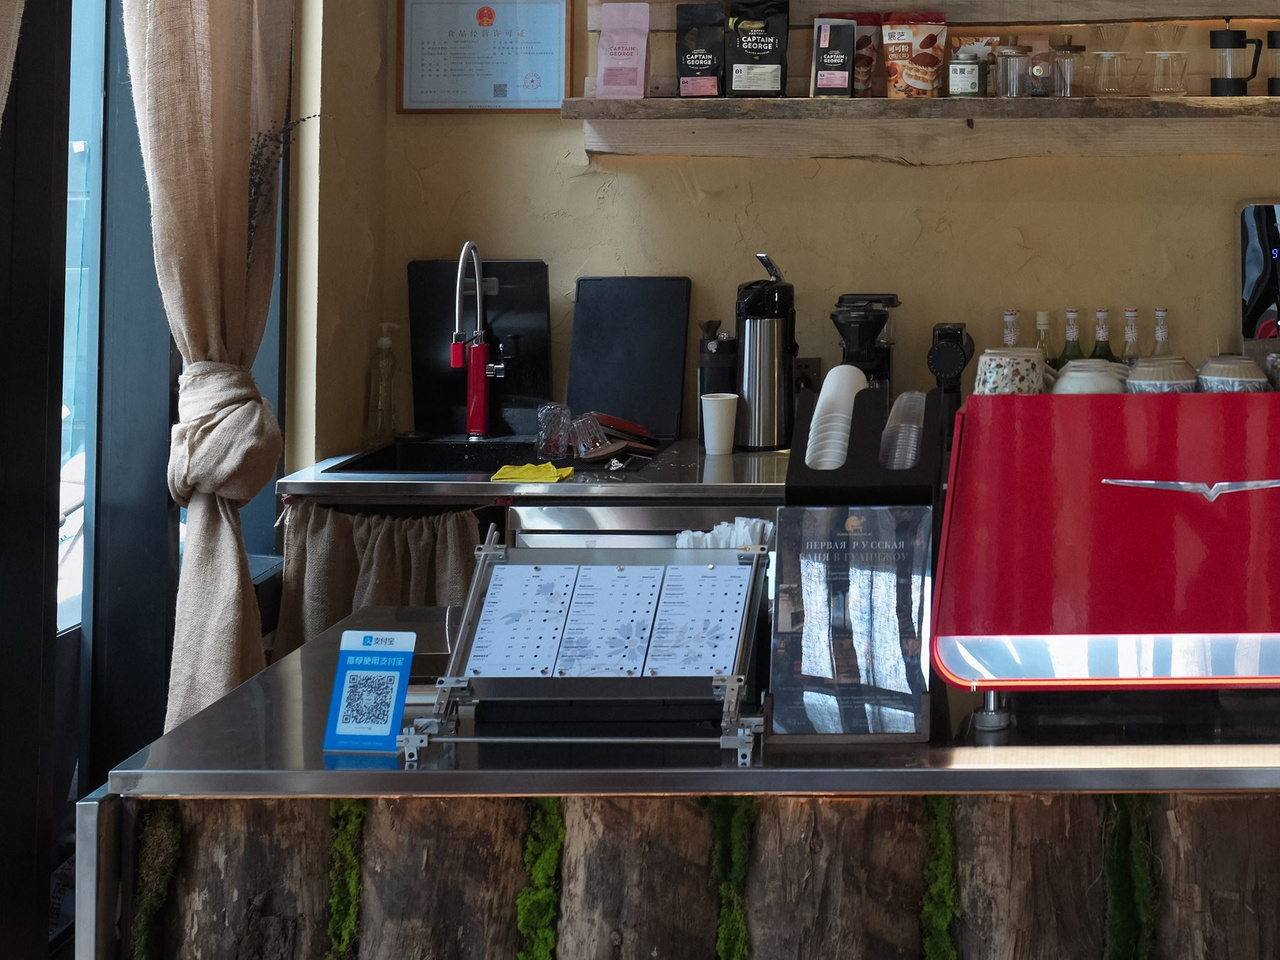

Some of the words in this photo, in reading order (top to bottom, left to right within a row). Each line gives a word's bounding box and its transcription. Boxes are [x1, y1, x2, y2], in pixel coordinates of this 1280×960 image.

[742, 42, 773, 50] GEORGE
[806, 541, 846, 550] ПЕРВАЯ
[373, 637, 395, 646] 支付宝
[346, 656, 405, 666] 推荐使用支付宝
